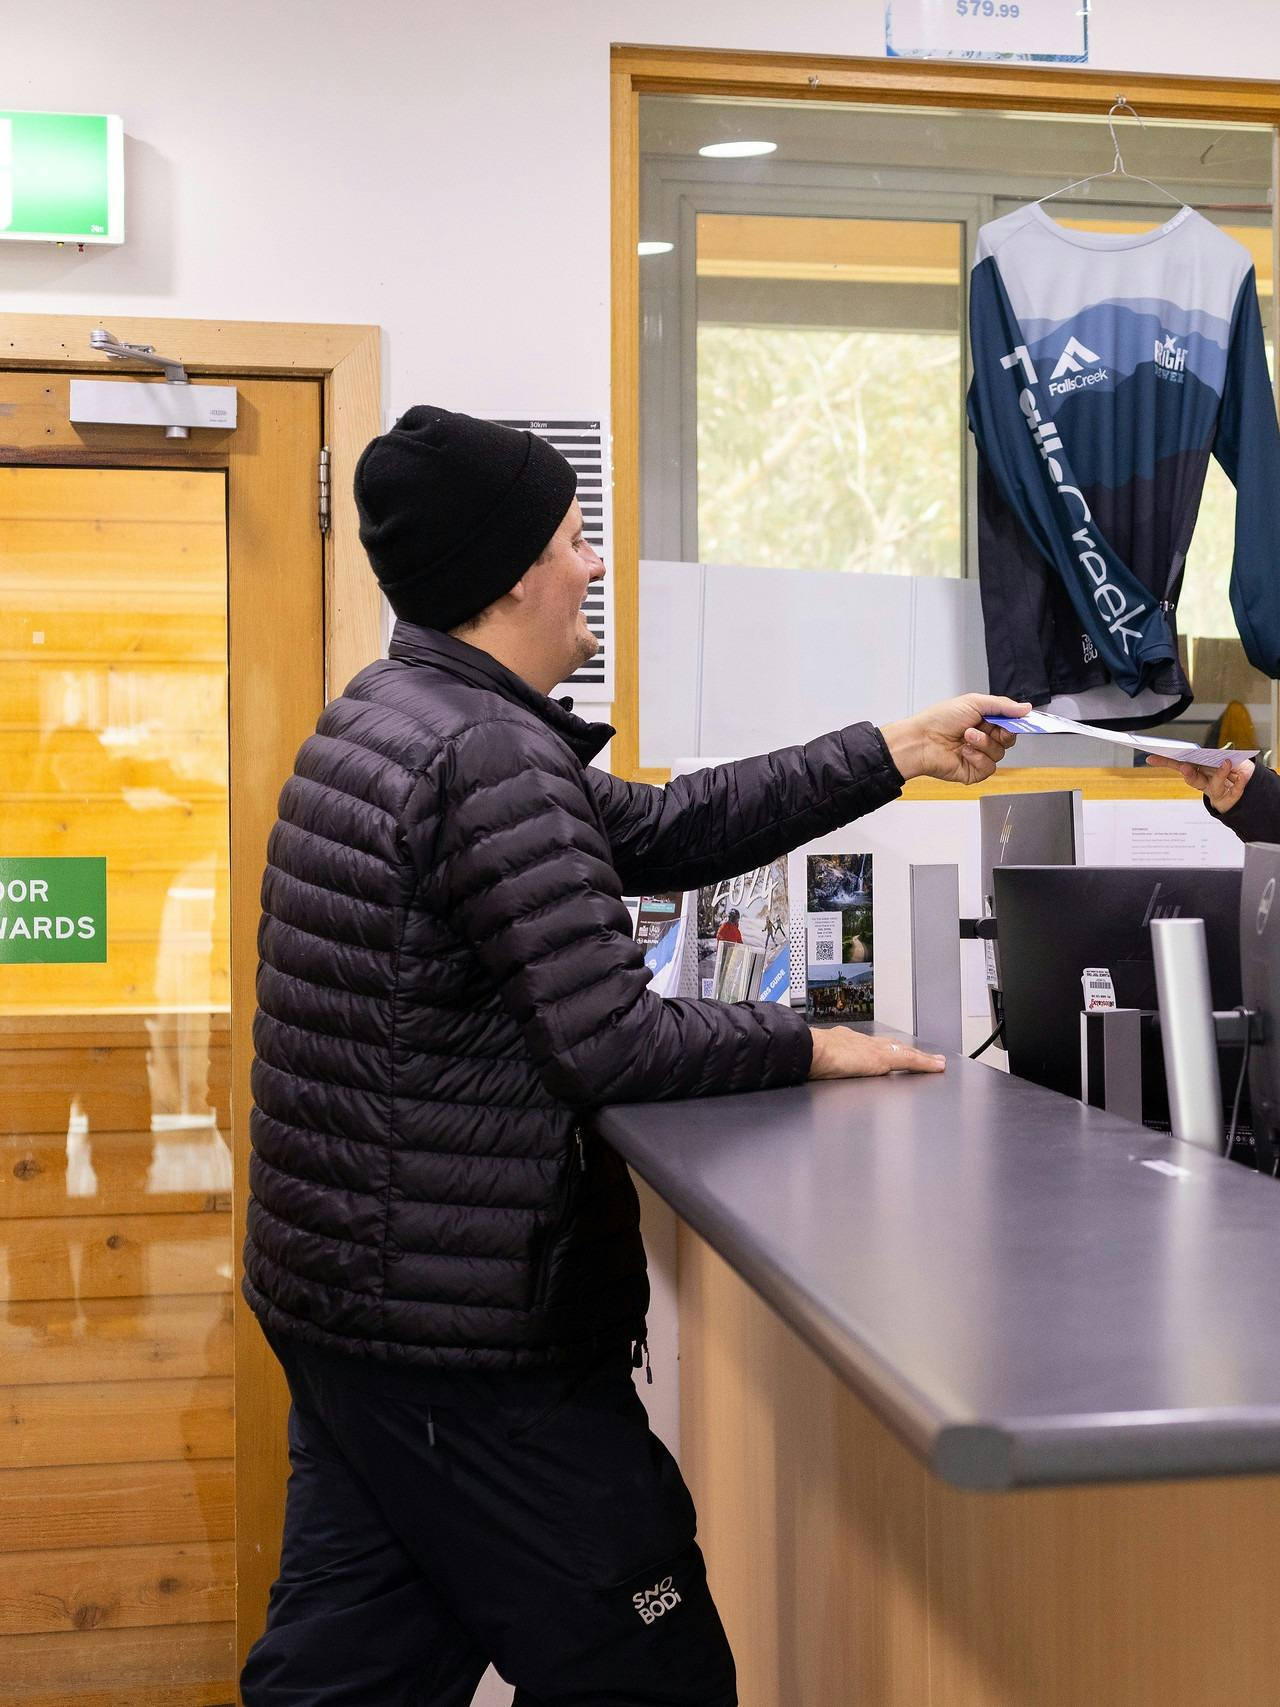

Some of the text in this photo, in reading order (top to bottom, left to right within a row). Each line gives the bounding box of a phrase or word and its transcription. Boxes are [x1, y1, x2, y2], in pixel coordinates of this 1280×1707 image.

[956, 0, 1020, 18] $79.99
[1049, 367, 1109, 397] FallsCreek
[0, 879, 49, 903] OR
[770, 968, 787, 990] GUIDE
[632, 1575, 673, 1609] SNO
